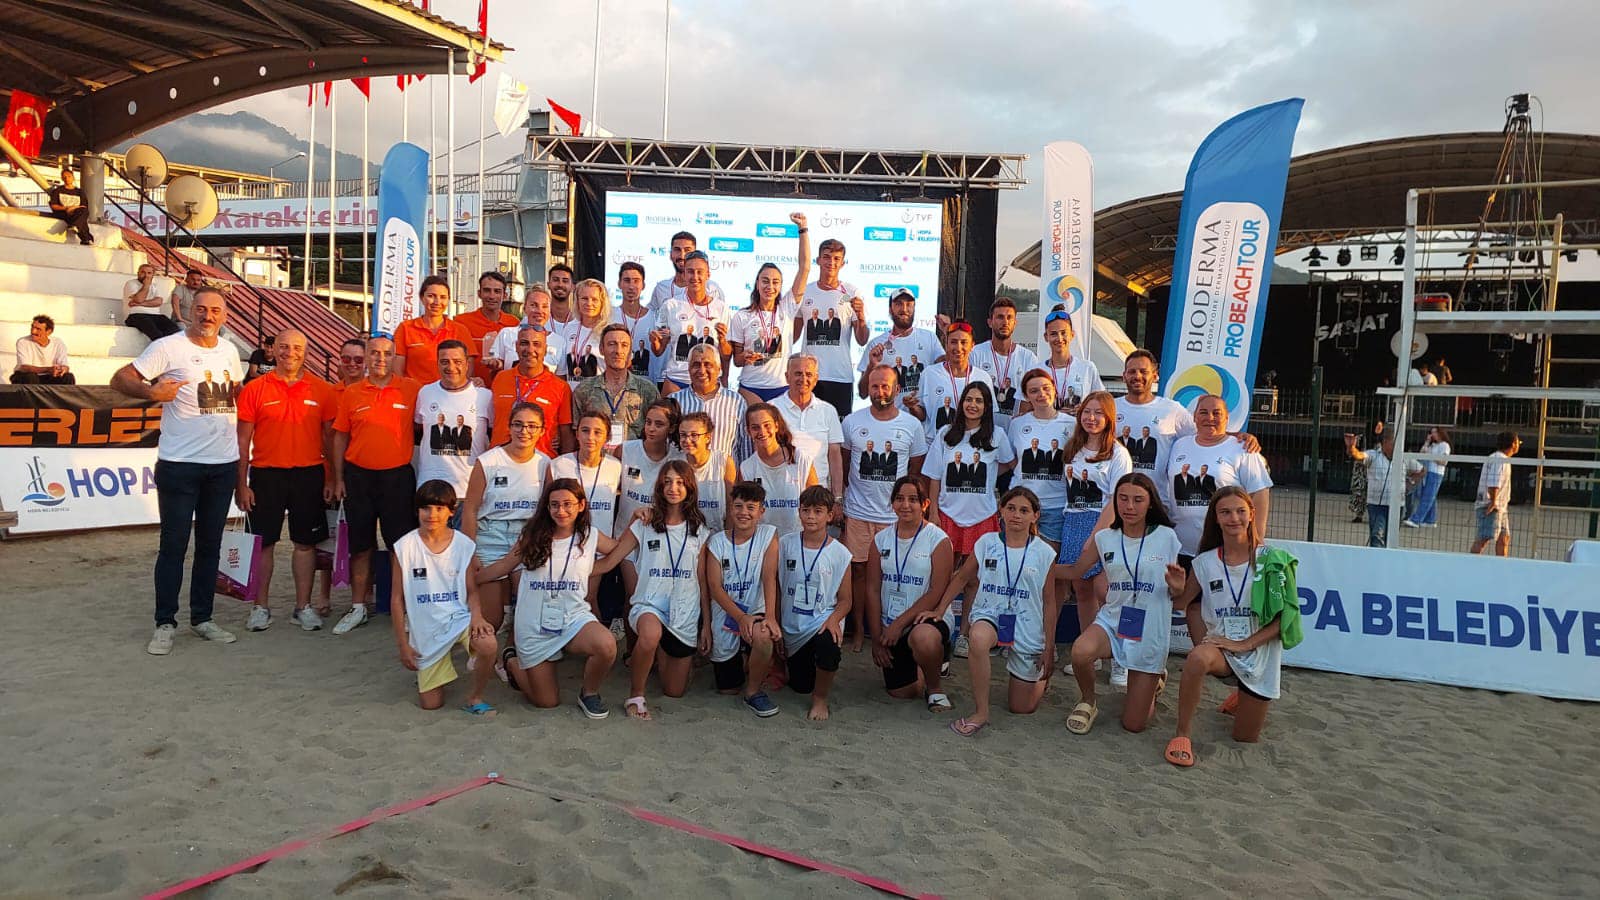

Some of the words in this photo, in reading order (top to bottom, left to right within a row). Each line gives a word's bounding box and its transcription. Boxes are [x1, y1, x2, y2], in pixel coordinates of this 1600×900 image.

[834, 217, 852, 225] TVF
[916, 213, 933, 221] TVF
[627, 255, 645, 263] TVF
[721, 260, 739, 268] TVF
[859, 263, 903, 272] BIODERMA
[382, 232, 397, 332] IODERMA
[403, 237, 415, 321] BEACHTOUR
[1185, 219, 1222, 353] BIODERMA
[1206, 300, 1219, 354] LABORATOIRE
[1214, 218, 1231, 296] DERMATOLOGIQUE
[1223, 218, 1261, 358] PROBEACHTOUR
[66, 466, 158, 498] HOPA
[494, 501, 510, 510] HOPA
[529, 580, 545, 591] HOPA
[893, 573, 924, 586] BLEDİYESİ
[1297, 586, 1351, 634] PA
